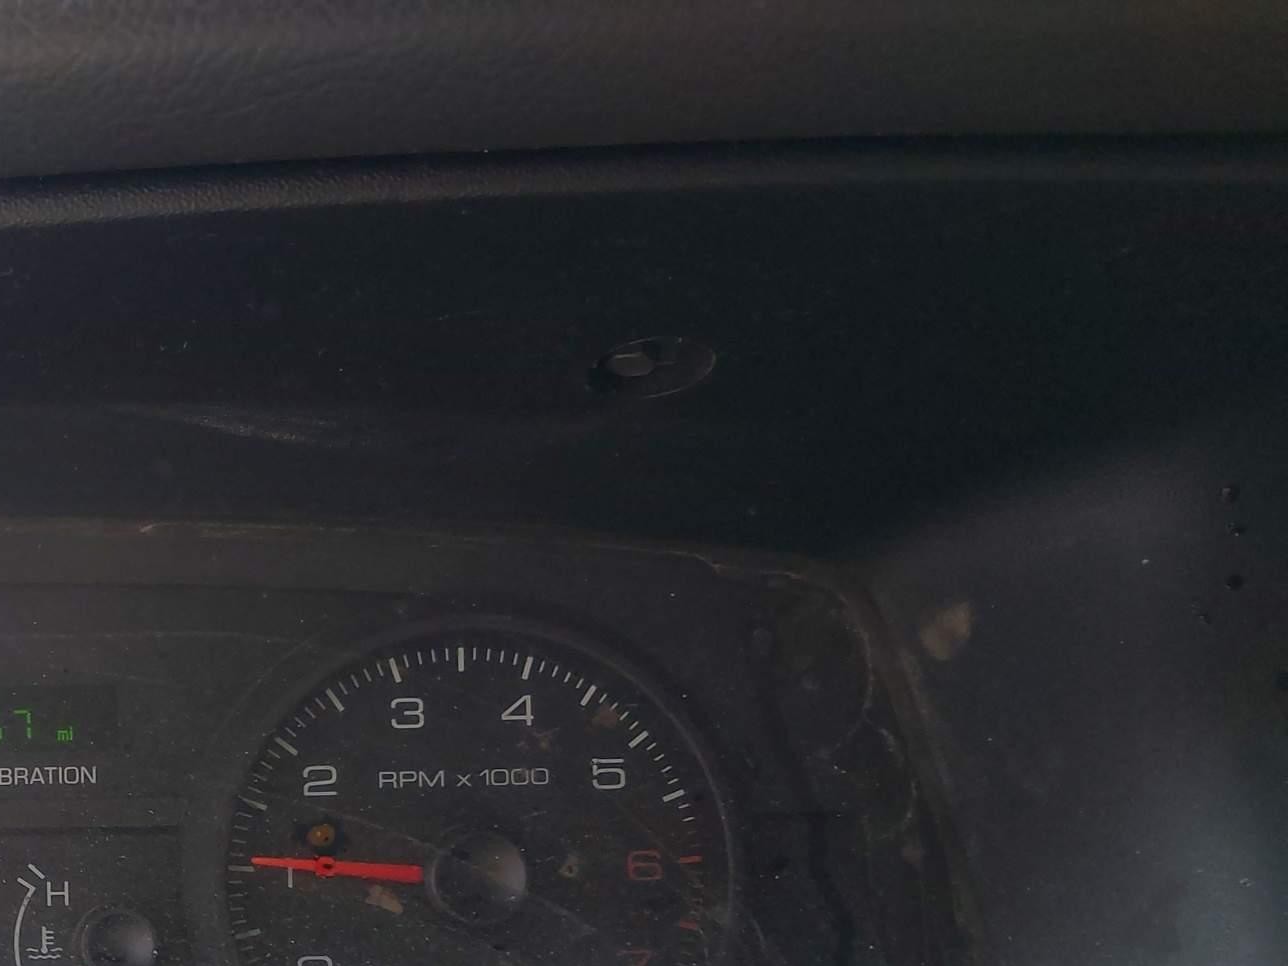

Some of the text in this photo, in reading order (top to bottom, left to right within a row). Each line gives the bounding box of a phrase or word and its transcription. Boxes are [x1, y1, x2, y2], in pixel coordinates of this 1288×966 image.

[390, 698, 425, 729] 3
[501, 695, 534, 726] 4
[303, 765, 338, 796] 2
[378, 770, 445, 789] RPM
[479, 768, 549, 785] 1000
[591, 758, 626, 790] 5
[627, 849, 663, 880] 6
[46, 881, 69, 906] H
